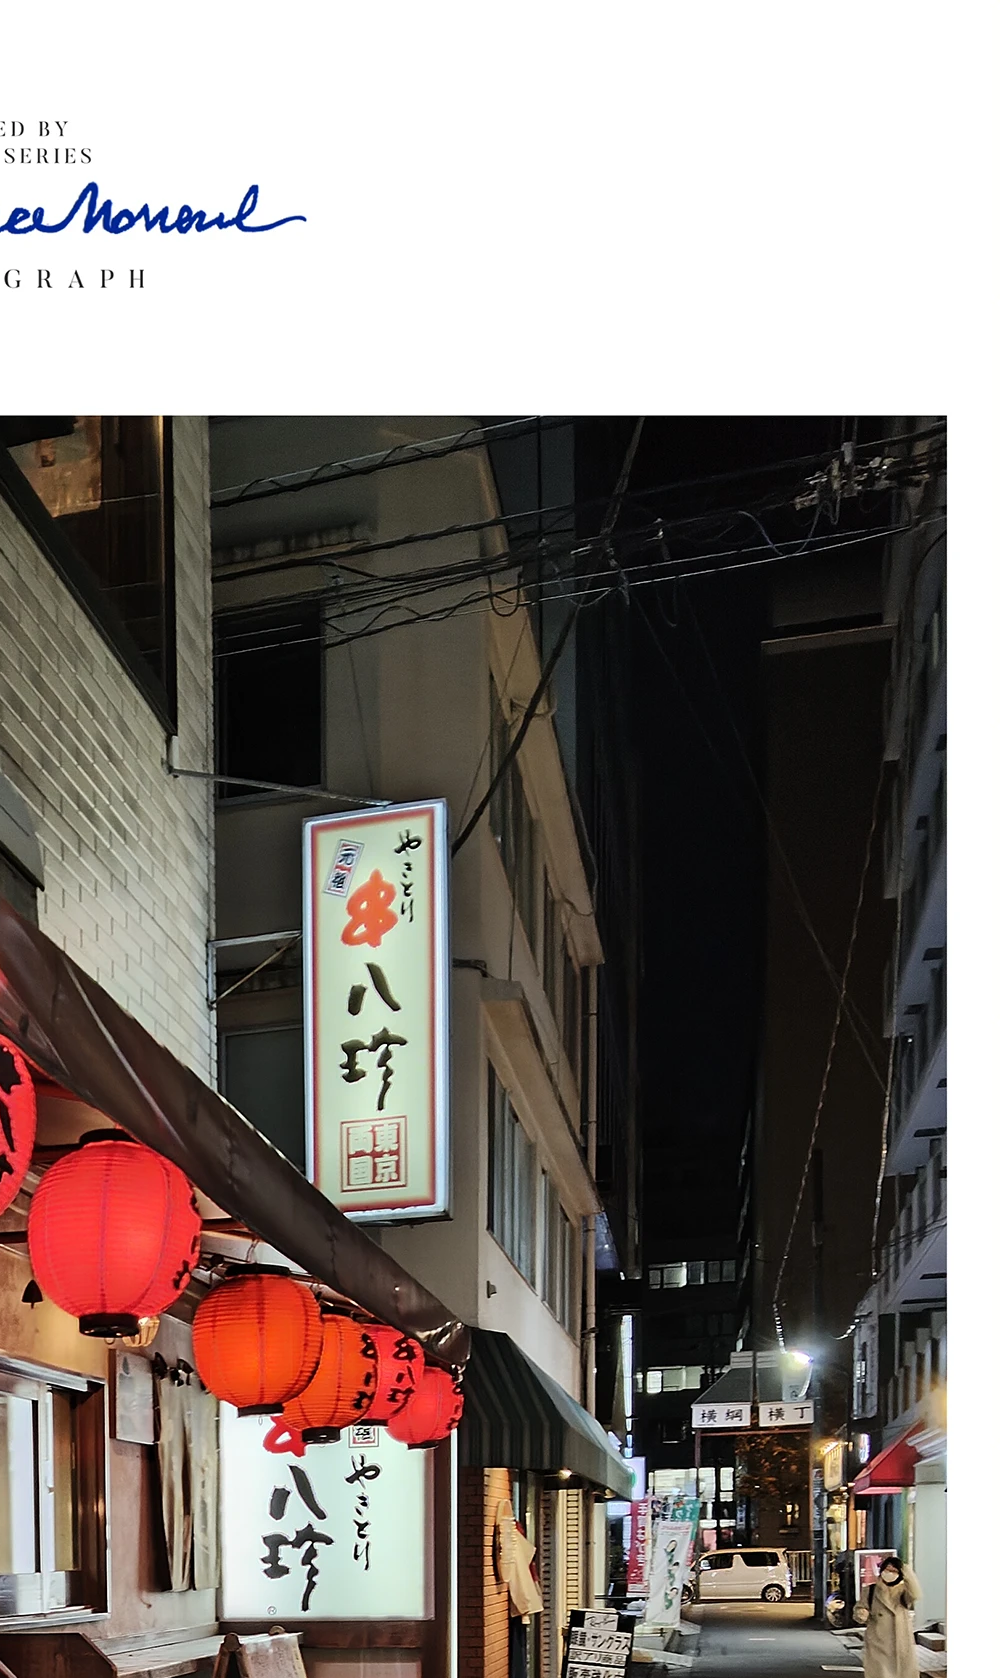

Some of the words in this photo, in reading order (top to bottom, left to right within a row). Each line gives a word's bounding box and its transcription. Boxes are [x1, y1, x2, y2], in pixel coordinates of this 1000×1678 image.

[340, 868, 408, 1112] 串八珍
[701, 1408, 743, 1423] 横綱
[768, 1406, 812, 1421] 横丁
